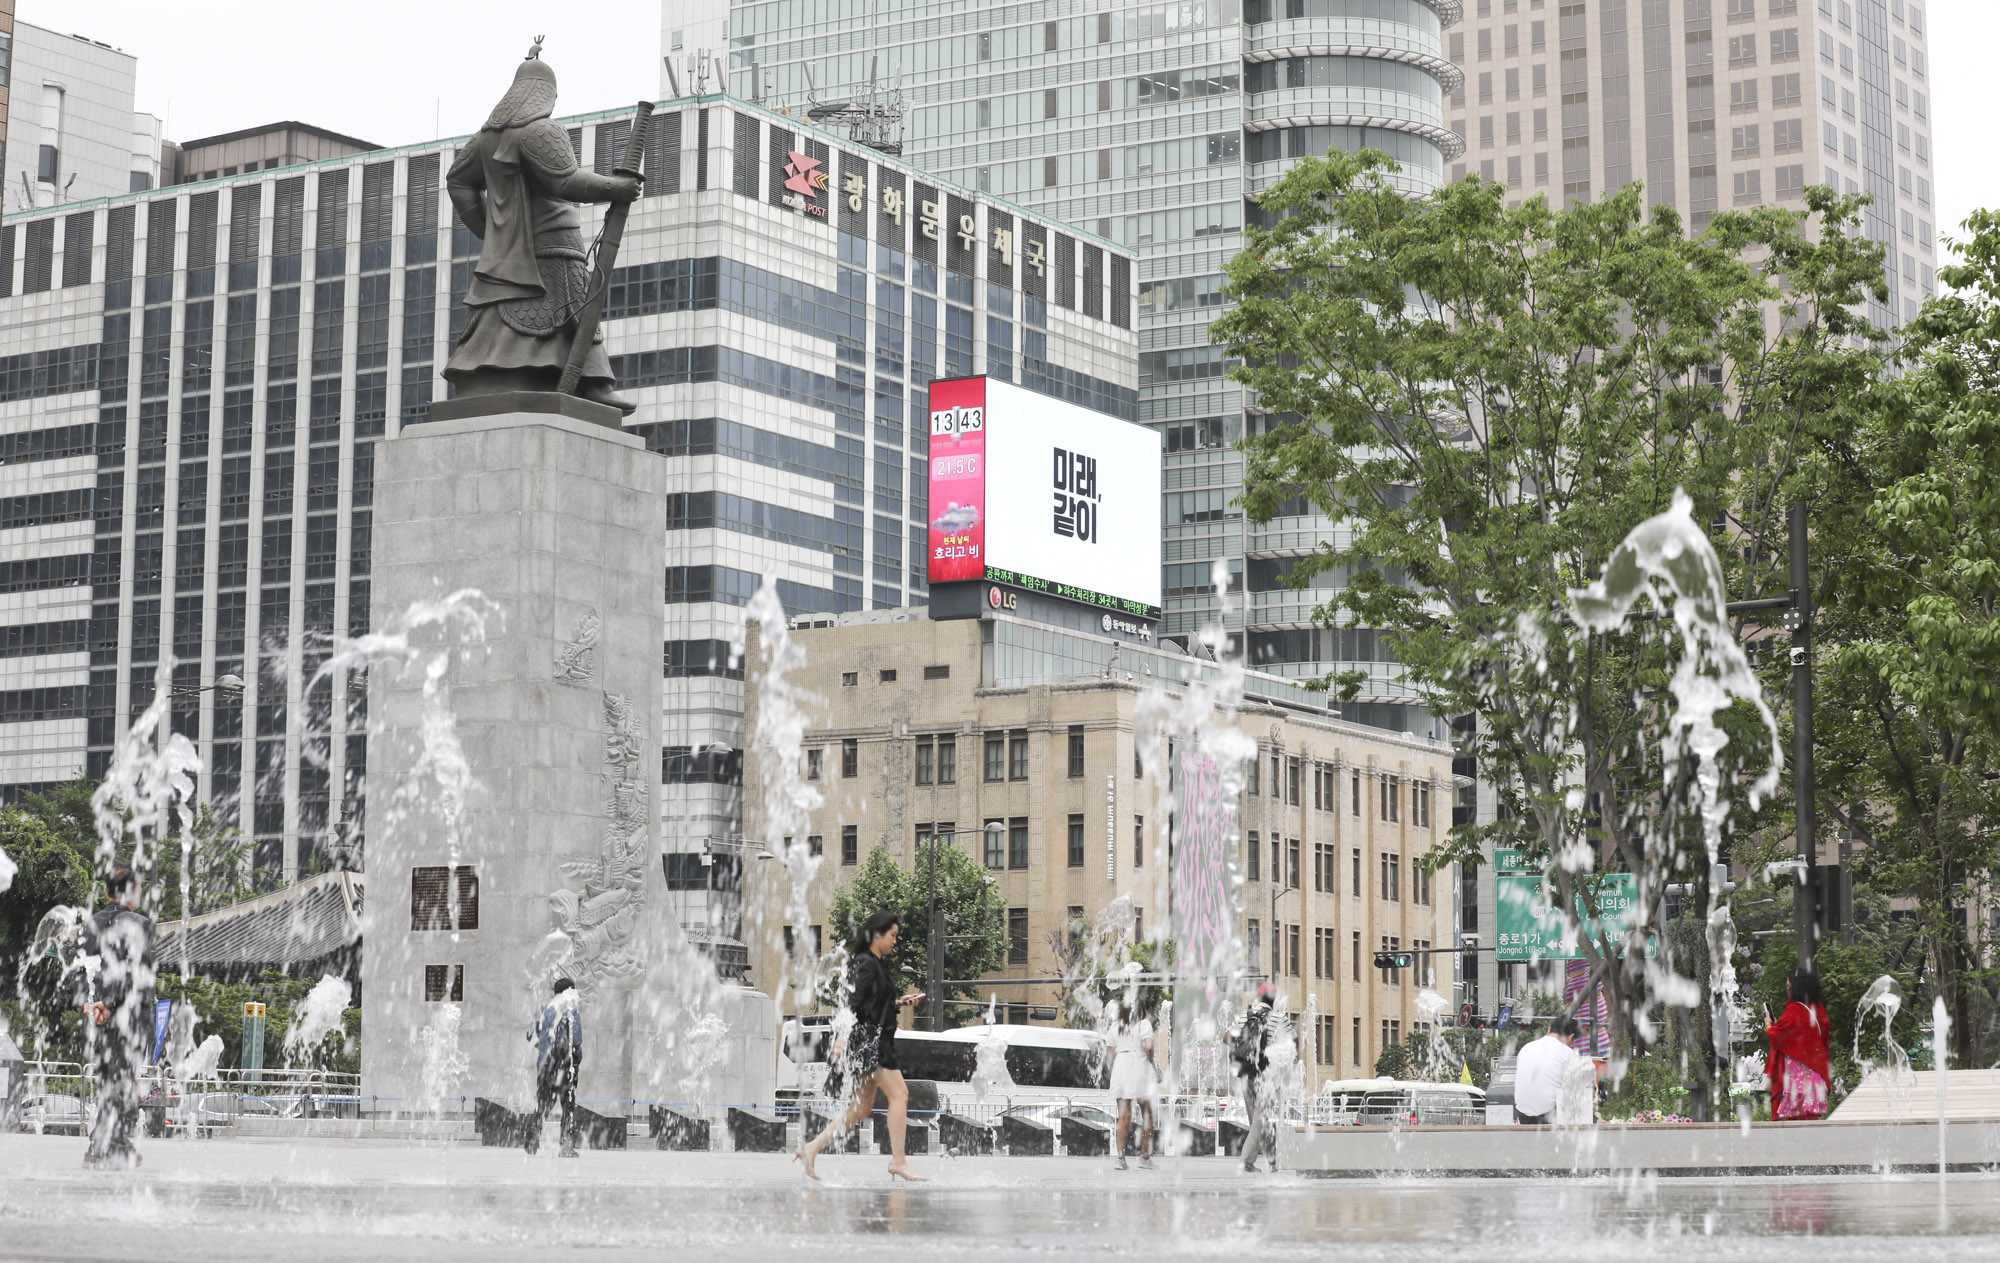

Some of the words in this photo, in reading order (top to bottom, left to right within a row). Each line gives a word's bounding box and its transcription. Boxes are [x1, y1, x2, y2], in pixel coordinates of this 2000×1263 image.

[807, 203, 827, 217] POST
[843, 171, 1046, 278] 광화문우체국
[1053, 491, 1097, 545] 같이
[933, 545, 967, 560] 흐리고
[969, 543, 979, 558] 비
[1002, 591, 1017, 610] LG
[1063, 584, 1097, 604] 하수처리장
[1111, 618, 1138, 635] 동아일보
[1498, 932, 1542, 946] 종로1가
[1498, 945, 1523, 956] Jongno
